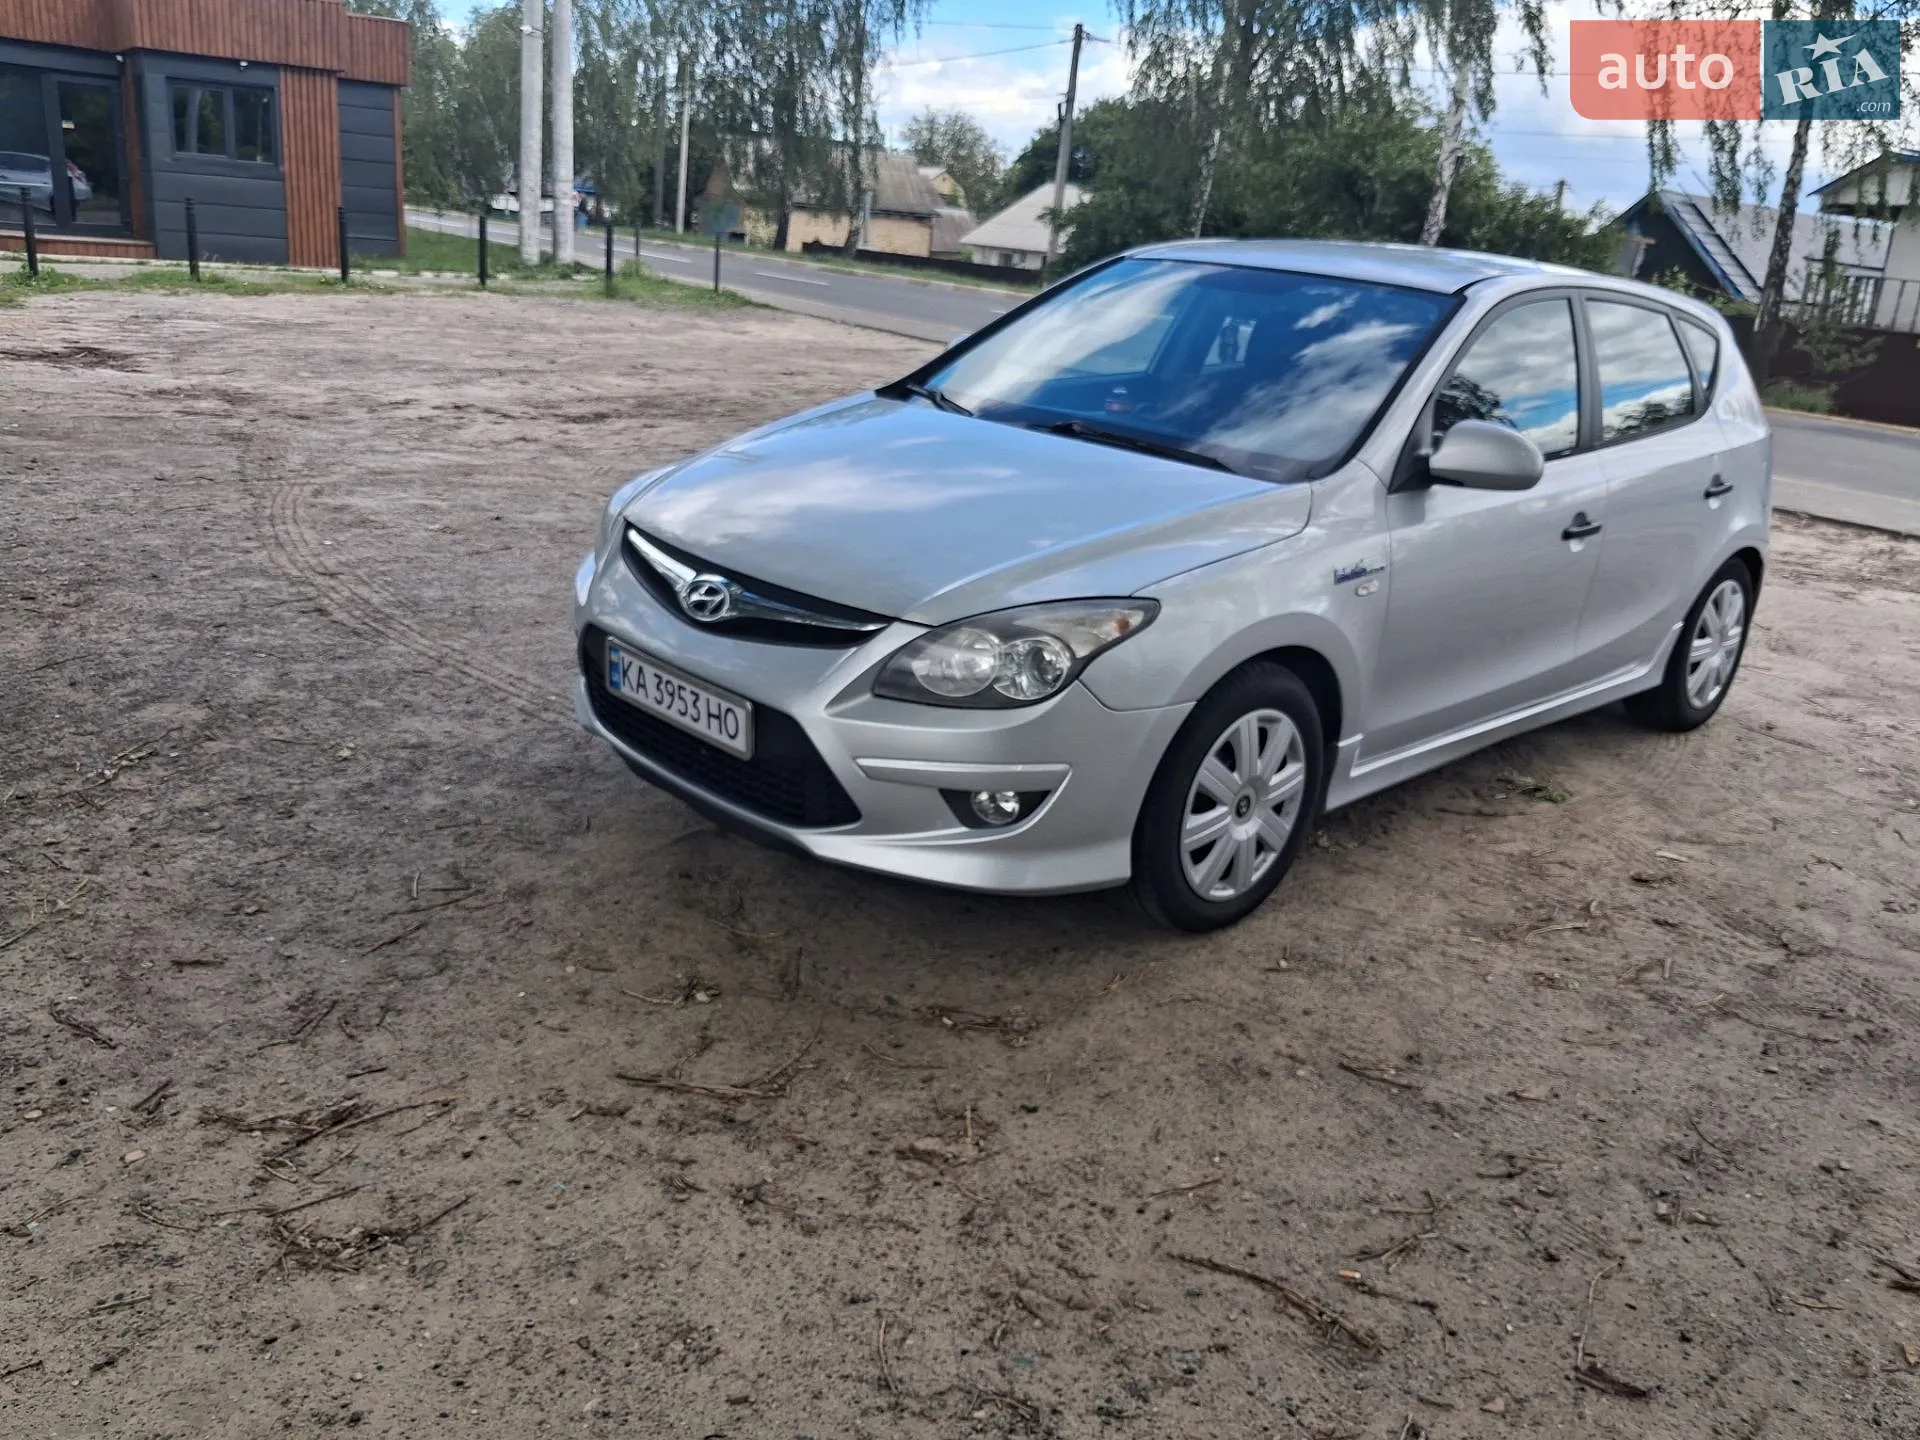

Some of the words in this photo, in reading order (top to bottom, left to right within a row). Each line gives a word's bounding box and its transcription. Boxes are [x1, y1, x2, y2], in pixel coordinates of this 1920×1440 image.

[622, 656, 648, 698] KA
[653, 673, 700, 723] 3953
[706, 697, 739, 740] HO
